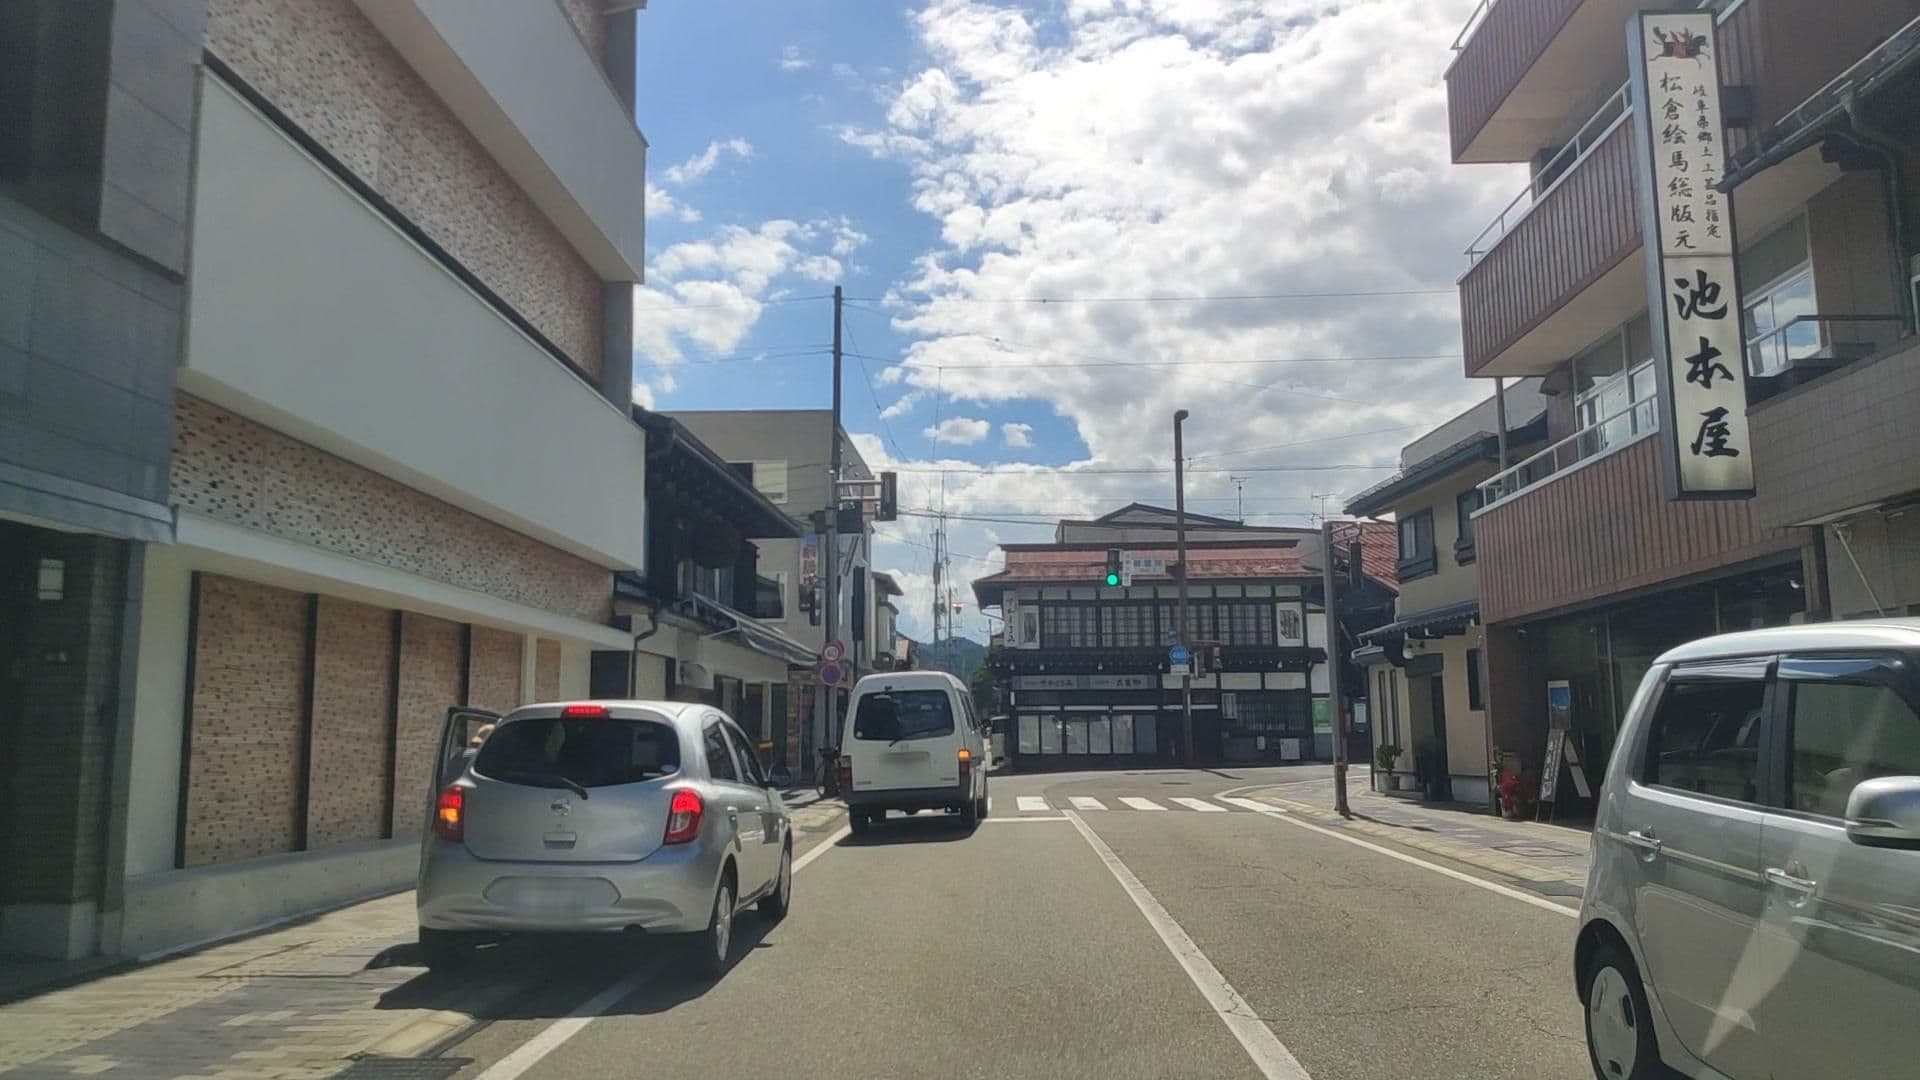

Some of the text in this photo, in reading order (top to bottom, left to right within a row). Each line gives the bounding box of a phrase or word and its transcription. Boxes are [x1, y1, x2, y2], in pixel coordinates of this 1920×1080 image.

[1660, 71, 1696, 249] 松倉絵馬総版元
[1673, 269, 1740, 458] 池本屋
